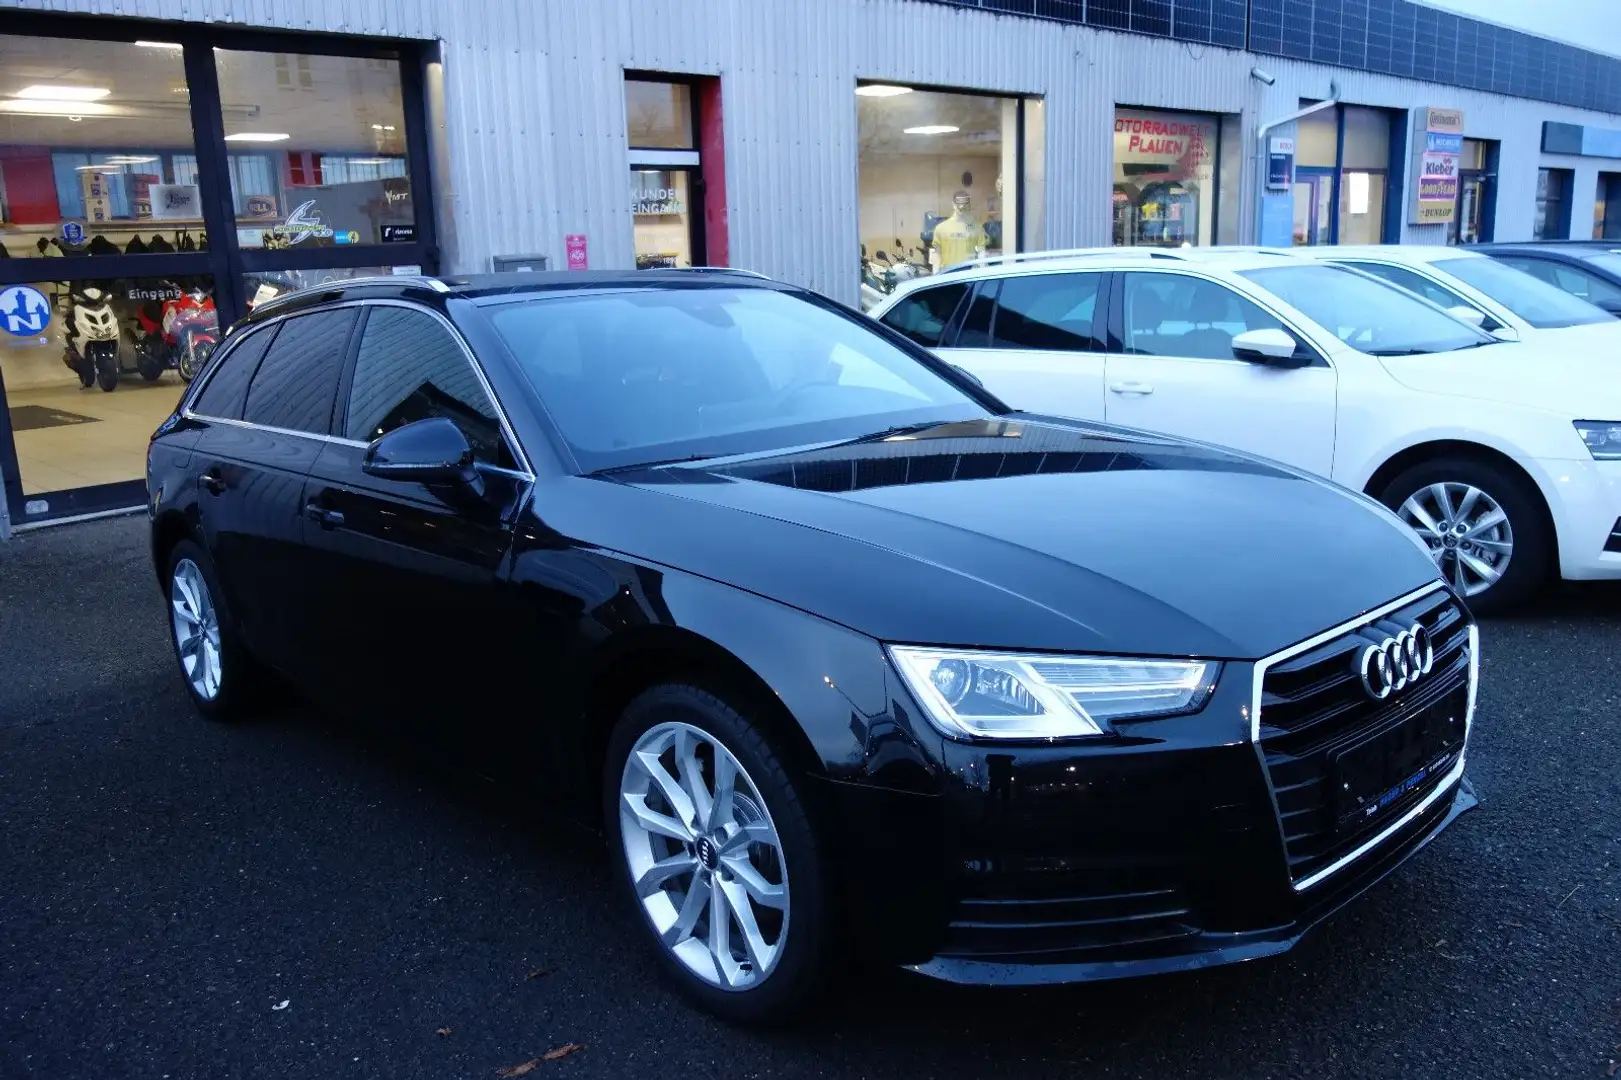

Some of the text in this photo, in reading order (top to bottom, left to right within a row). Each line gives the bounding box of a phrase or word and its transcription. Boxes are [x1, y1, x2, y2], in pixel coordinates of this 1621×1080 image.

[1113, 118, 1209, 137] OTORRADWELT
[1128, 136, 1183, 156] PLAUEN
[1426, 161, 1454, 176] Kleber
[631, 188, 679, 201] KUNDE
[631, 202, 683, 214] EINGAN
[1424, 208, 1452, 218] DUNLOP
[128, 288, 182, 301] Eingang
